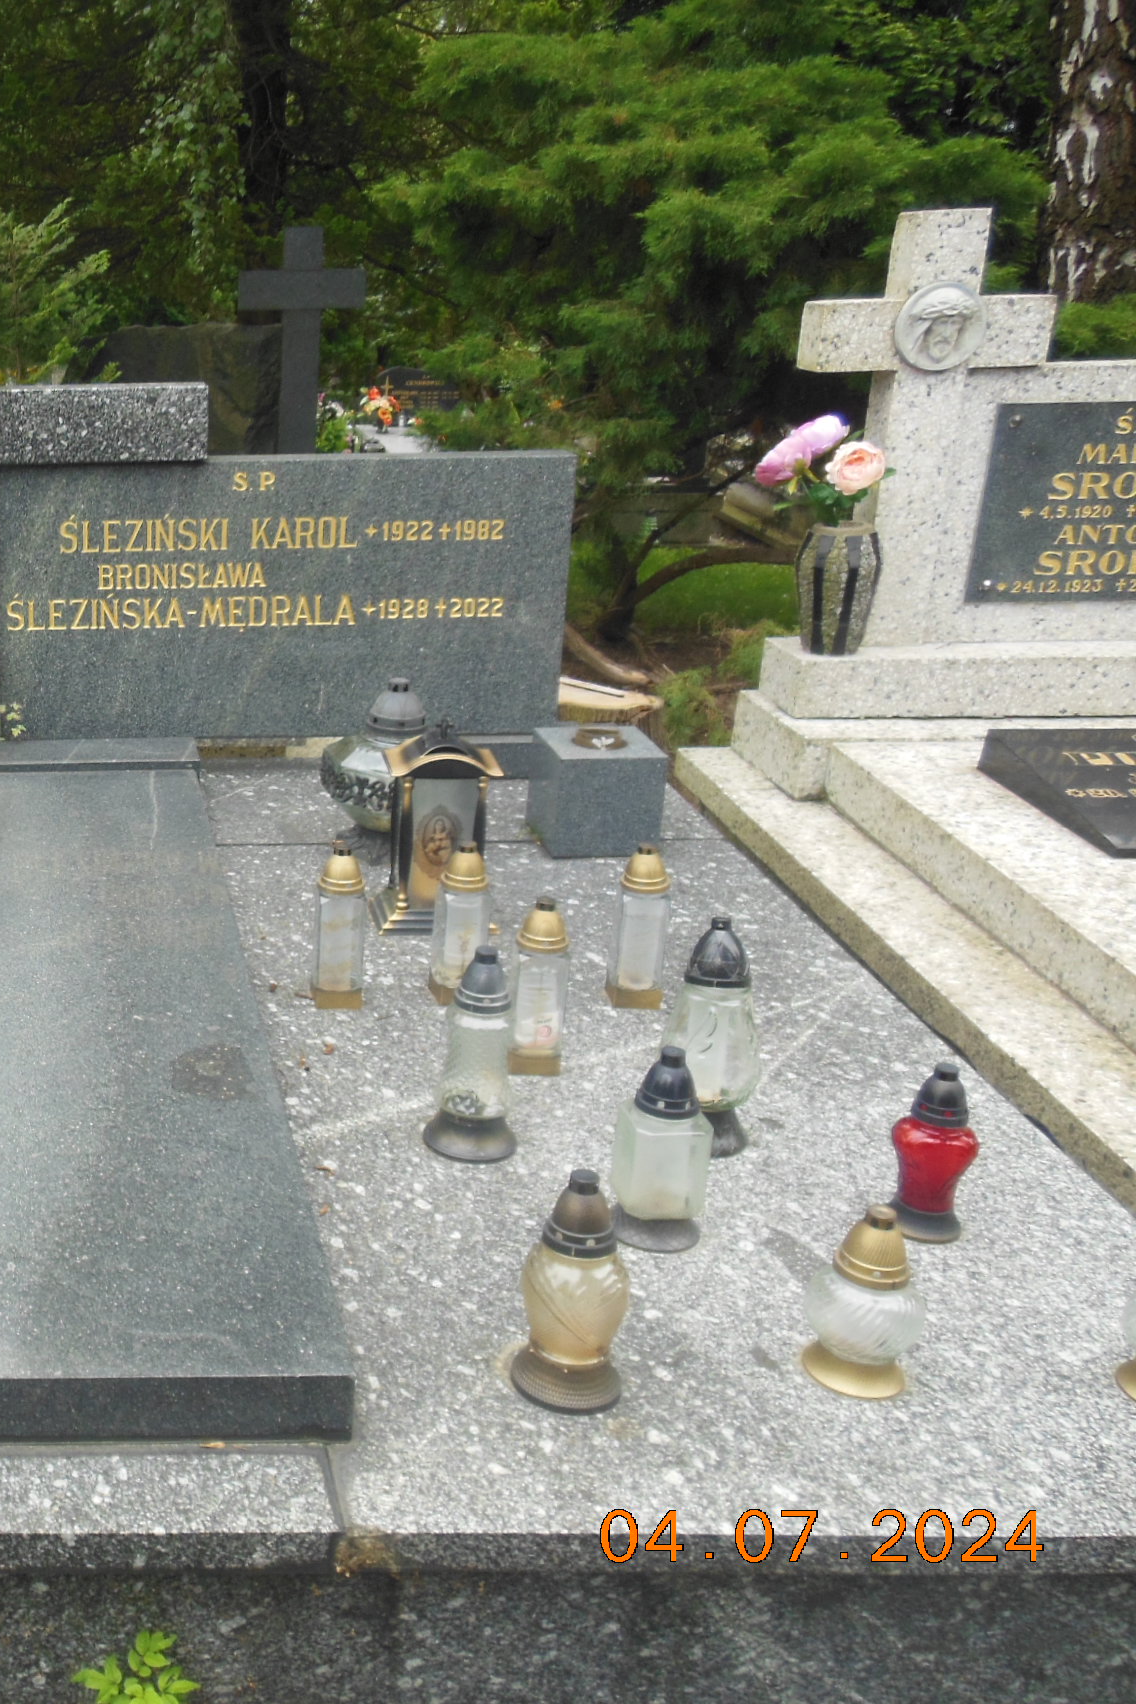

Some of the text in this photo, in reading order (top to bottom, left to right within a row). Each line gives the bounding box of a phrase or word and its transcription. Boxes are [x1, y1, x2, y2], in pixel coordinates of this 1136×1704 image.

[1076, 443, 1136, 465] MA
[59, 514, 229, 554] ŚLEZIŃSKI
[250, 515, 359, 549] KAROL
[97, 562, 267, 590] BRONISŁAWA
[1033, 549, 1136, 576] SRO
